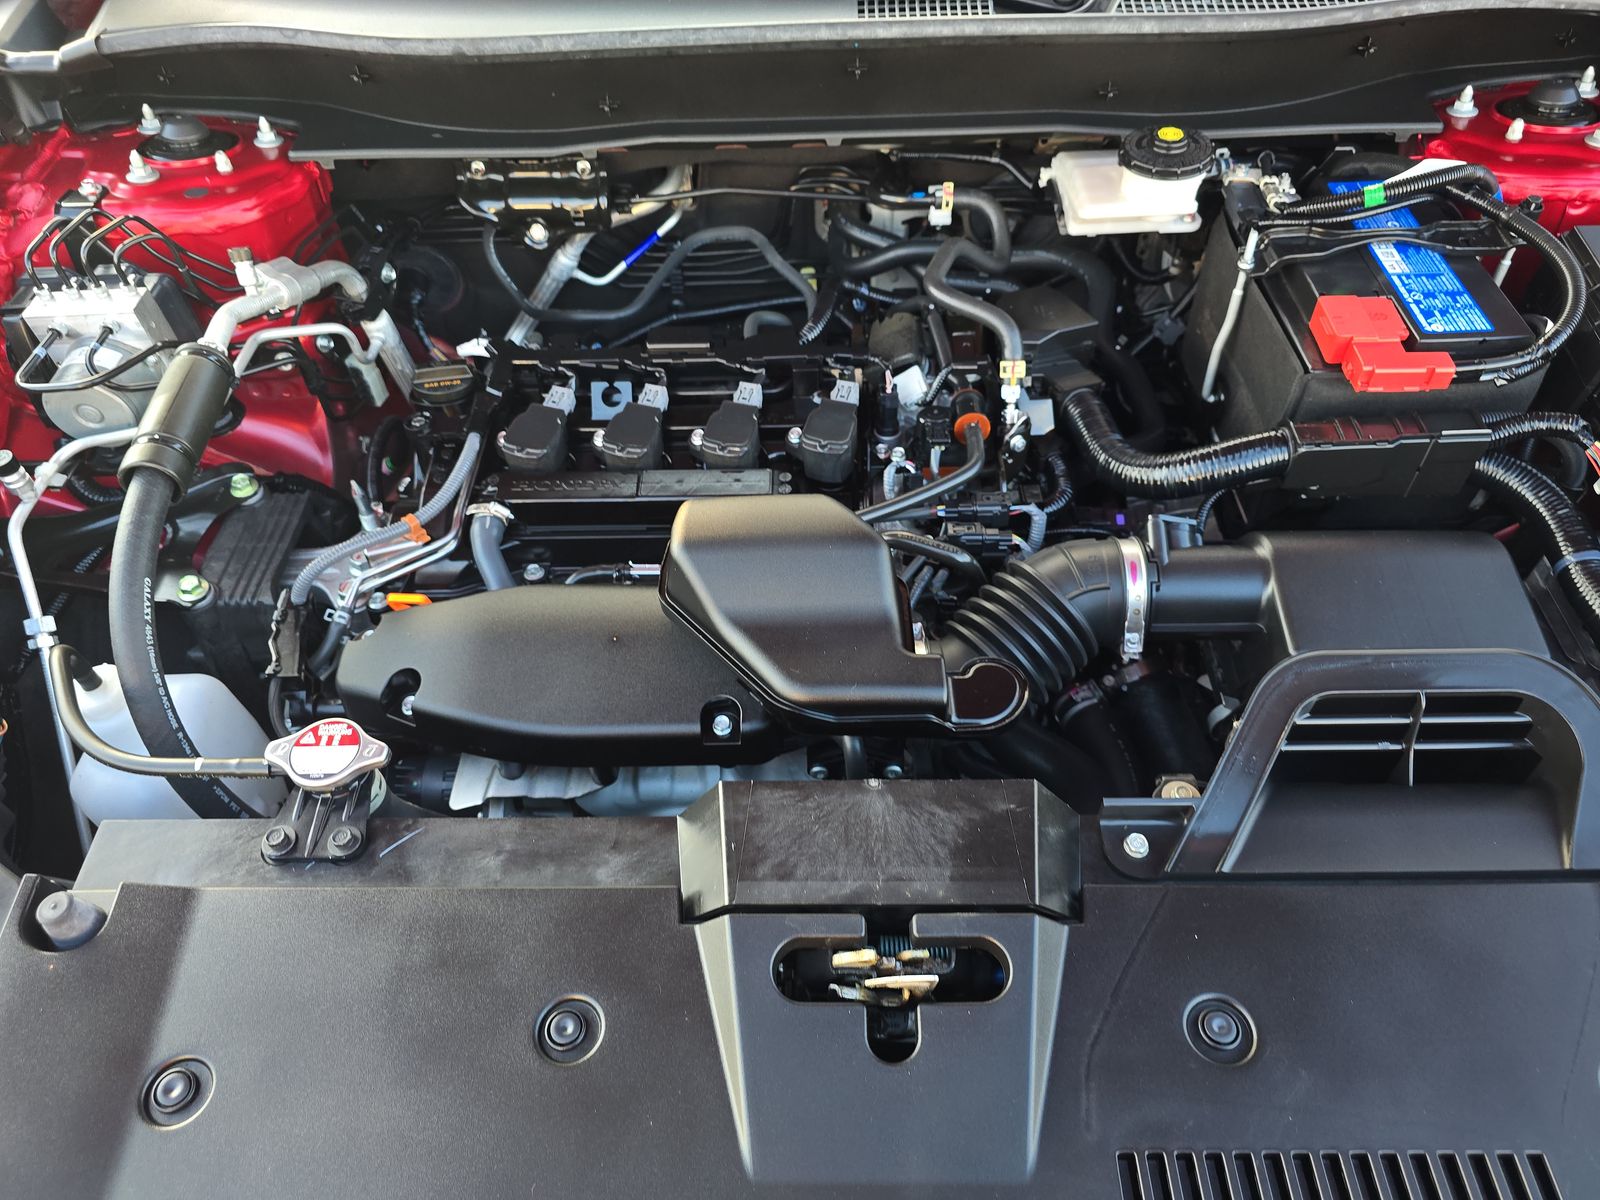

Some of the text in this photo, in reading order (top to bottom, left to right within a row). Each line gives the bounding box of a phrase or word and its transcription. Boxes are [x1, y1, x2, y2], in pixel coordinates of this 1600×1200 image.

[143, 576, 152, 623] GALAXY
[145, 624, 154, 645] 4843
[165, 709, 180, 730] HOSE
